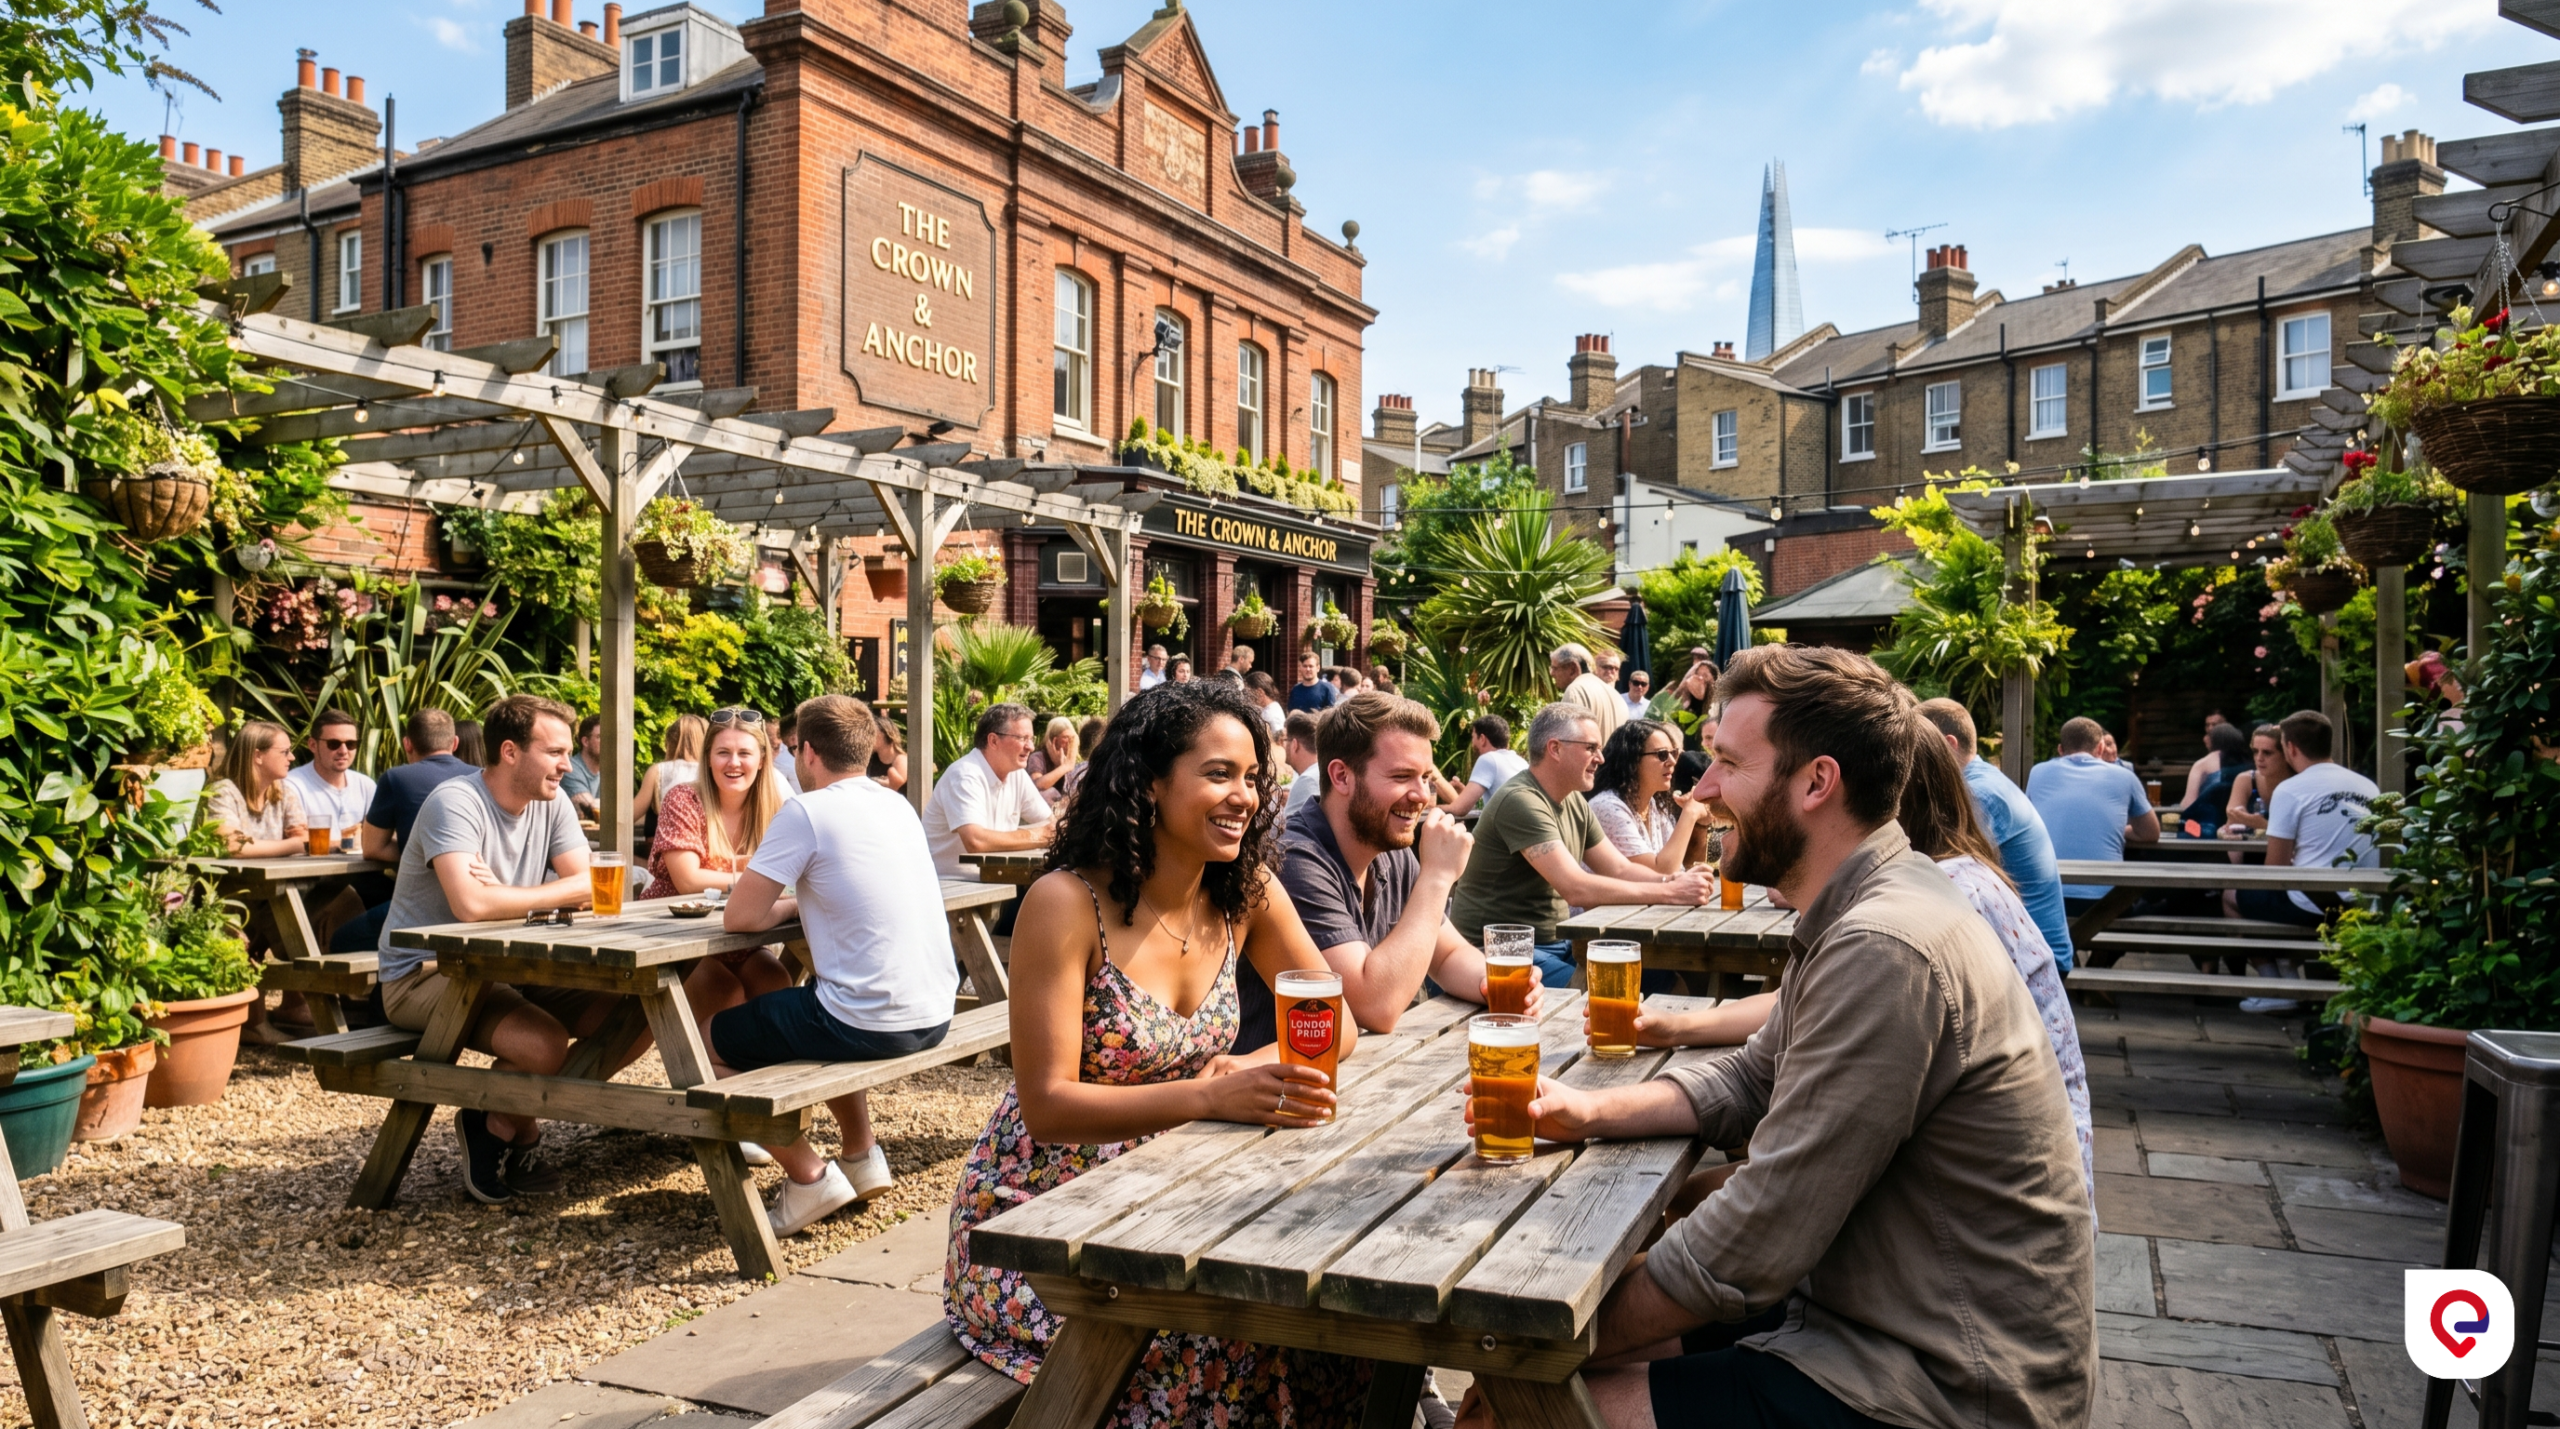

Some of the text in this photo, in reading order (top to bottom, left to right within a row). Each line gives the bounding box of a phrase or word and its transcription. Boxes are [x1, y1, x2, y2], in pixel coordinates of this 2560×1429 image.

[897, 201, 951, 250] THE
[871, 236, 973, 300] CROWN
[914, 293, 932, 328] &
[862, 321, 978, 384] ANCHOR
[1174, 508, 1337, 562] THE CROWN & ANCHOR
[1297, 1029, 1326, 1038] PRIDE
